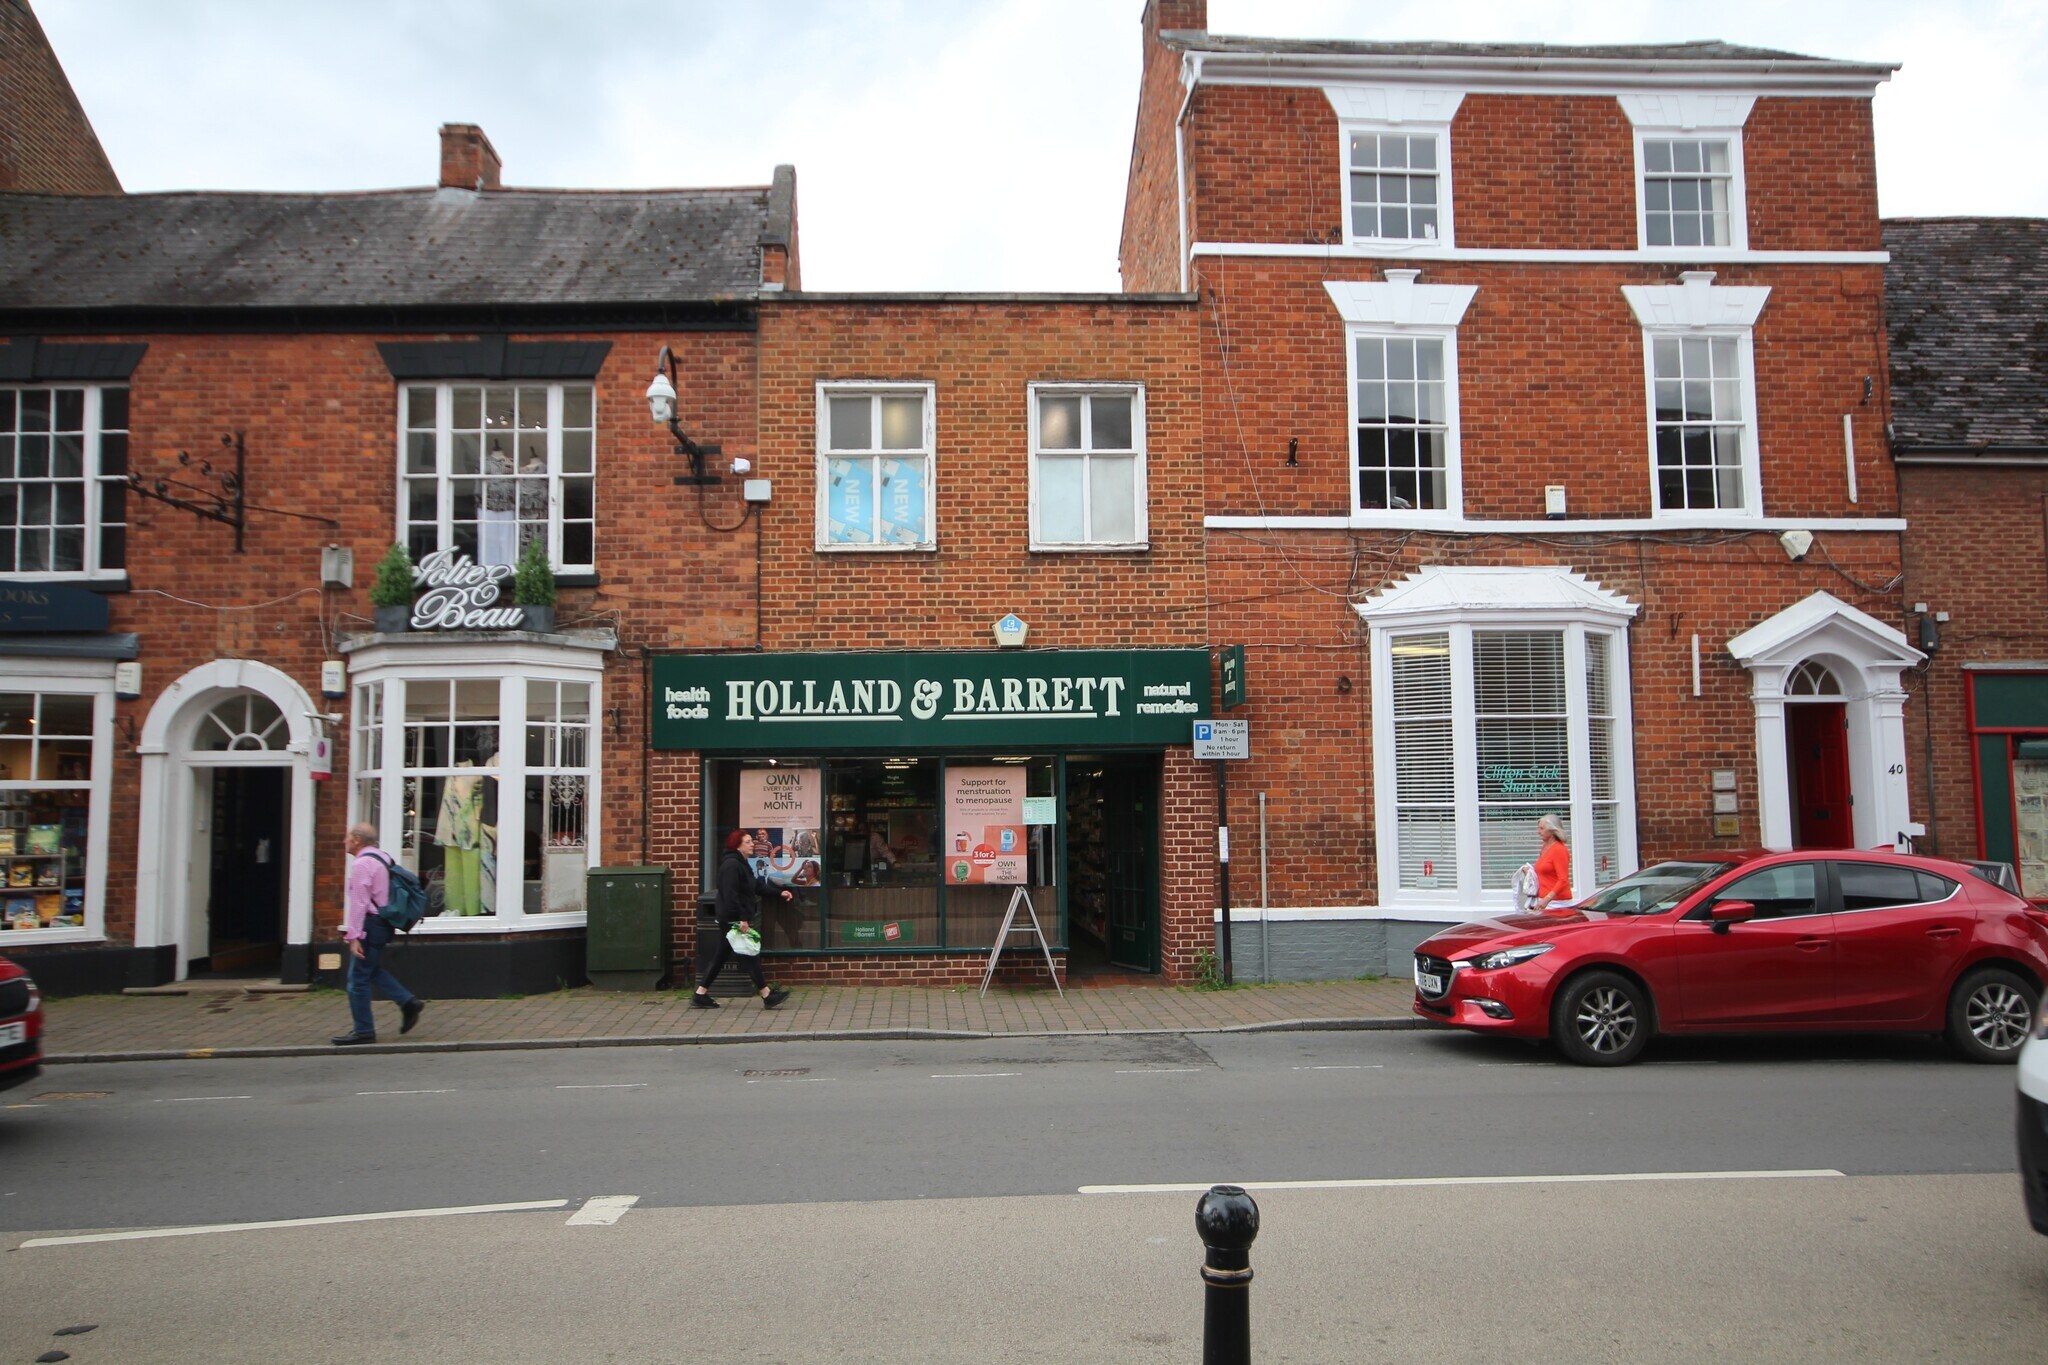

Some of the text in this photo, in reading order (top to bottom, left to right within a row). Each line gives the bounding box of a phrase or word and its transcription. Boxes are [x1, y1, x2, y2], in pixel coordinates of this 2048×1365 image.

[845, 479, 860, 524] NEW
[893, 479, 909, 523] NEW
[413, 545, 487, 587] Jolie
[410, 587, 525, 629] Beau
[665, 686, 711, 702] health
[1143, 682, 1191, 697] natural
[725, 677, 1126, 721] HOLLAND & BARRETT
[1136, 699, 1199, 715] remedies
[666, 704, 709, 719] foods
[1484, 764, 1559, 783] Clifton Crick
[1888, 764, 1904, 775] 40
[766, 774, 800, 785] OWN
[961, 778, 1007, 788] Support for
[773, 792, 793, 800] THE
[1501, 780, 1537, 797] Sharp
[1540, 783, 1548, 792] &
[764, 801, 802, 810] MONTH
[966, 798, 1013, 807] menopause
